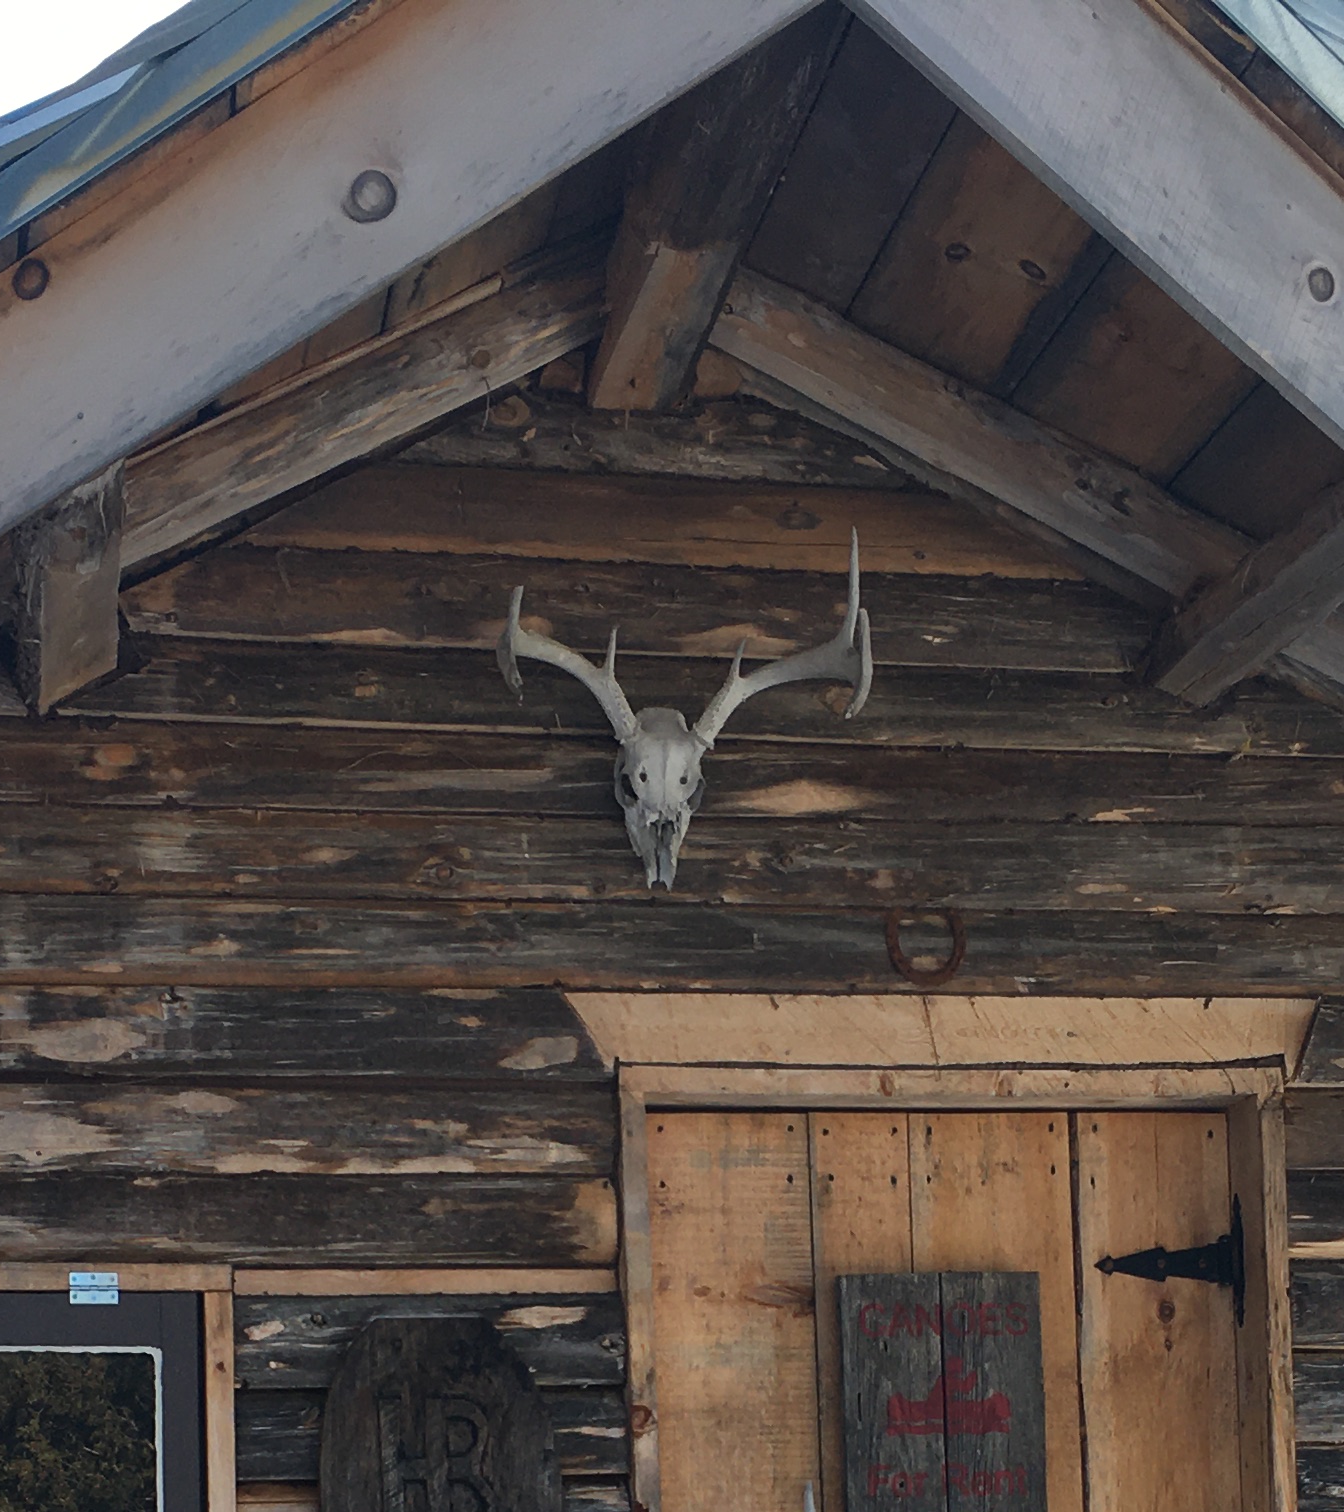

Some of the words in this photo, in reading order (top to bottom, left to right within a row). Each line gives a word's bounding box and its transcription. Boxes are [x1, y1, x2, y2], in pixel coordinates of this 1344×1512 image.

[858, 1301, 1030, 1340] CANOES
[866, 1462, 929, 1498] For
[941, 1462, 1029, 1498] Rent
